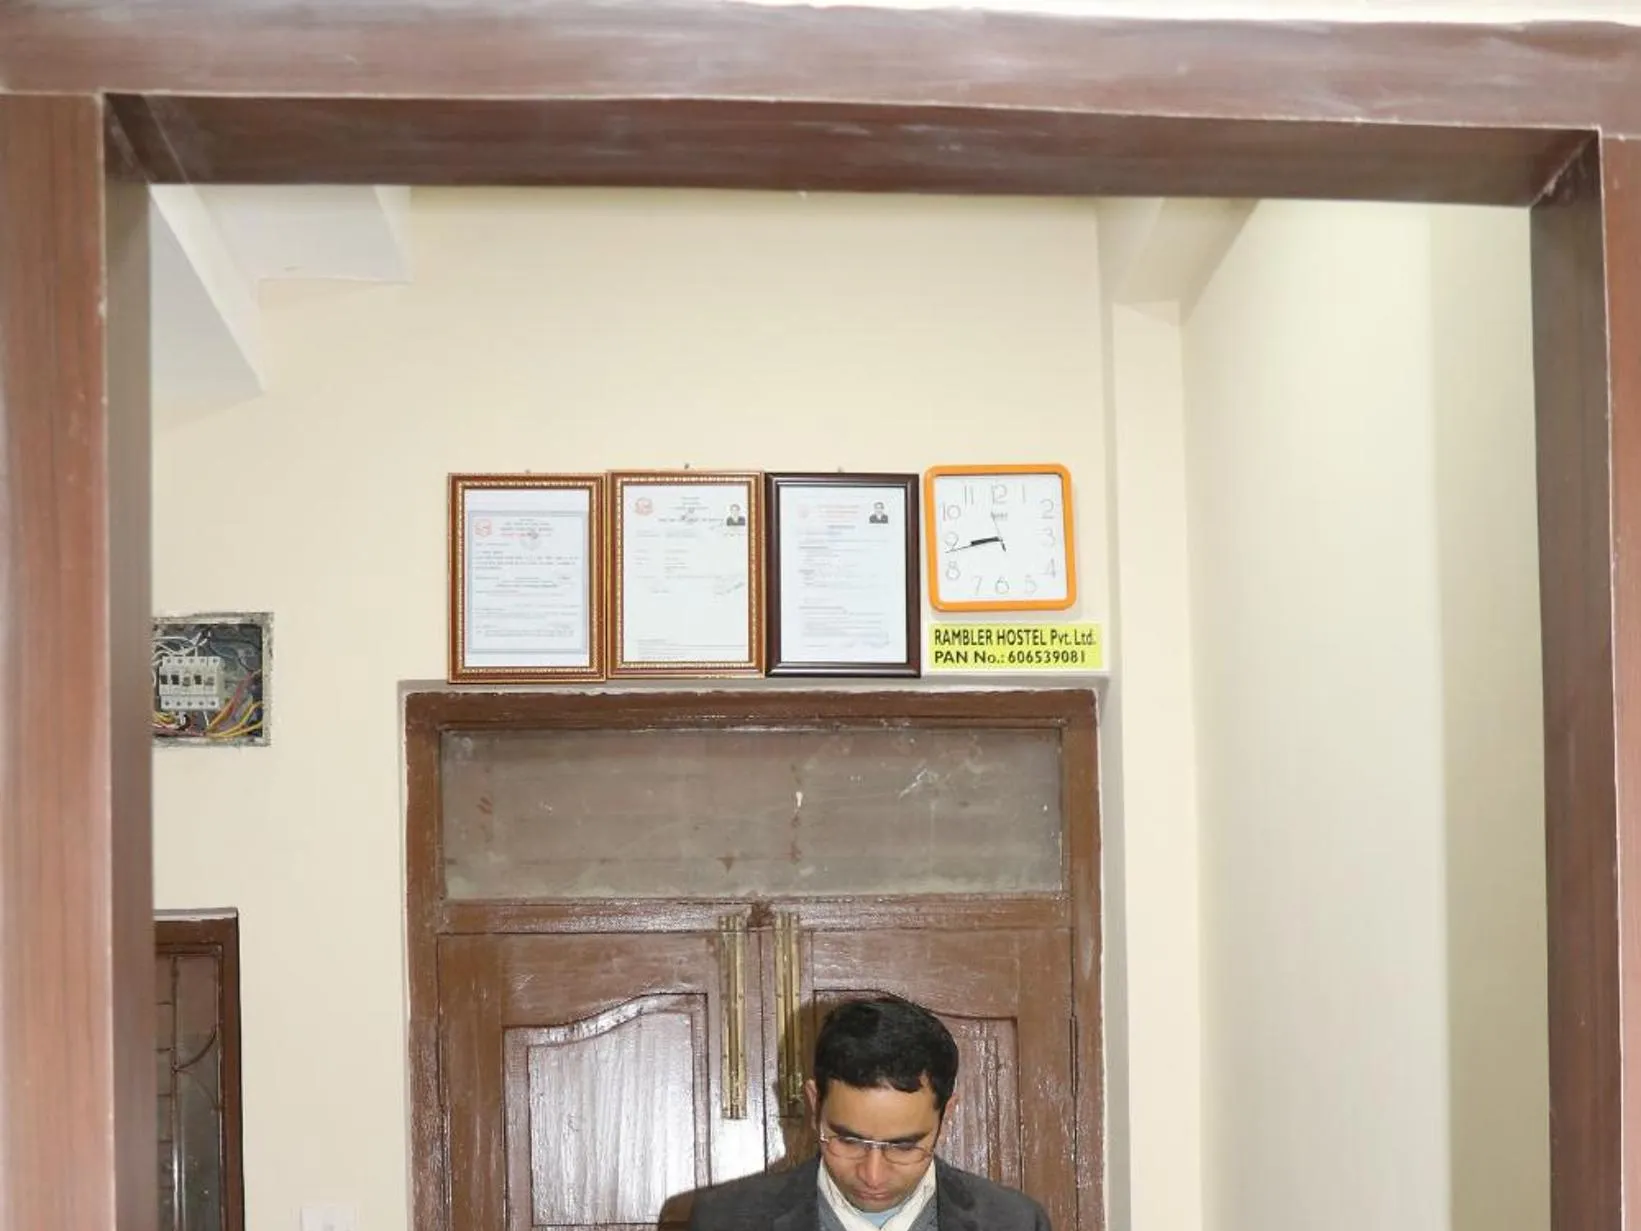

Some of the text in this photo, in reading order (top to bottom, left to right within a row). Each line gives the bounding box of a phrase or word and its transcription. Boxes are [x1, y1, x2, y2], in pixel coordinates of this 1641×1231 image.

[963, 485, 974, 505] 11
[991, 484, 1007, 504] 12
[942, 502, 962, 521] 10
[1040, 498, 1055, 519] 2
[944, 531, 960, 551] 9
[1041, 527, 1056, 548] 3
[945, 560, 961, 581] 8
[1042, 558, 1057, 578] 4
[971, 575, 983, 596] 7
[994, 575, 1010, 595] 6
[1023, 574, 1039, 595] 5
[934, 628, 1097, 646] RAMBLER HOSTEL Pvt. Ltd.
[934, 650, 1086, 664] PAN No.: 606539081
